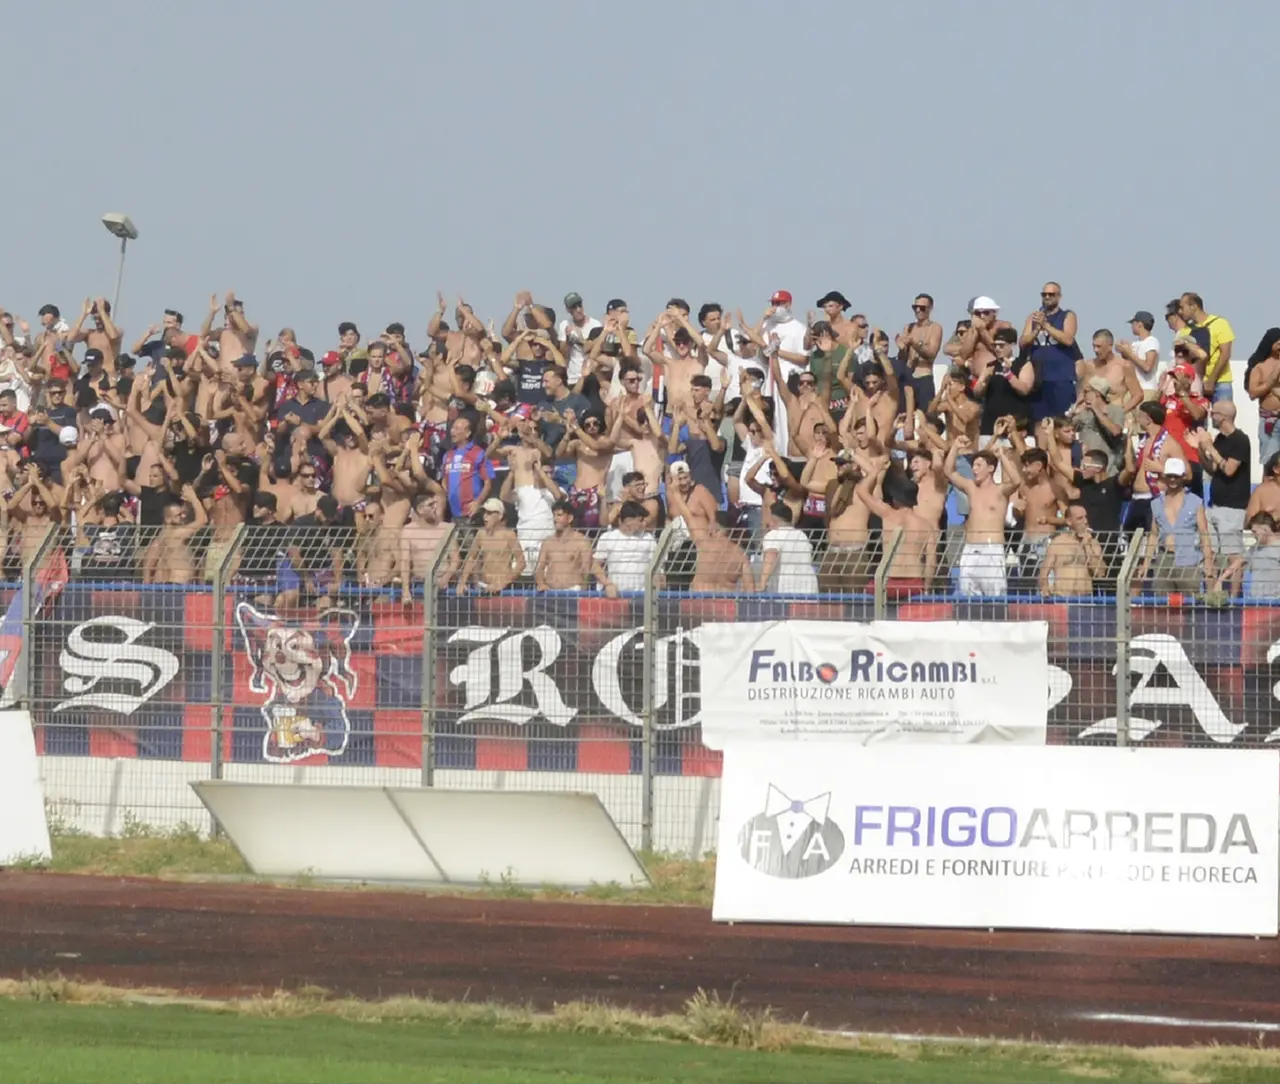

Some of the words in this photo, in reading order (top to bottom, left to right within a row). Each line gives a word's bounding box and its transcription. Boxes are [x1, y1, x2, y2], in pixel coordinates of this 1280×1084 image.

[748, 687, 852, 701] DISTRIBUZIONE
[858, 688, 915, 700] RICAMBI
[920, 688, 956, 700] AUTO
[853, 805, 1259, 855] FRIGOARREDA
[849, 857, 919, 876] ARREDI
[926, 858, 936, 876] E
[942, 858, 1050, 877] FORNITURE
[1057, 862, 1093, 880] PR
[1162, 866, 1171, 881] E
[1178, 866, 1258, 884] HORECA
